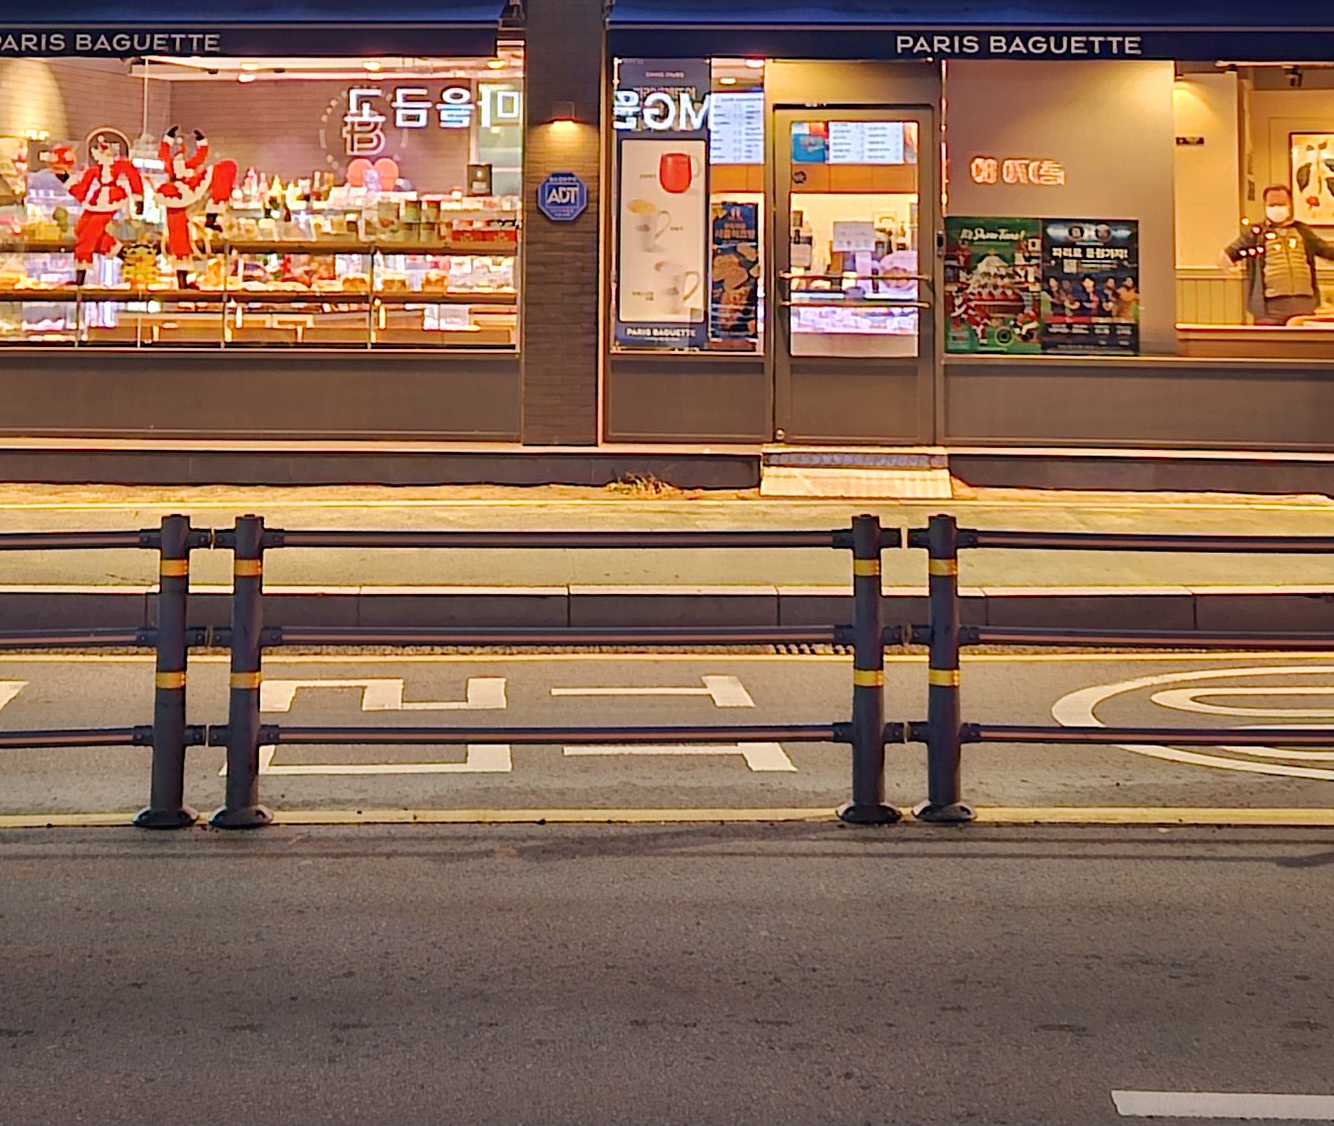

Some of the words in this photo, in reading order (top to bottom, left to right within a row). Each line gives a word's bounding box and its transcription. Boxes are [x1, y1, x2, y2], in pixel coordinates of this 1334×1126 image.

[75, 34, 221, 52] BAGUETTE
[896, 36, 980, 54] PARIS
[990, 36, 1142, 55] BAGUETTE
[547, 186, 579, 204] ADT
[626, 327, 652, 337] PARIS
[652, 328, 697, 338] BAGUETTE
